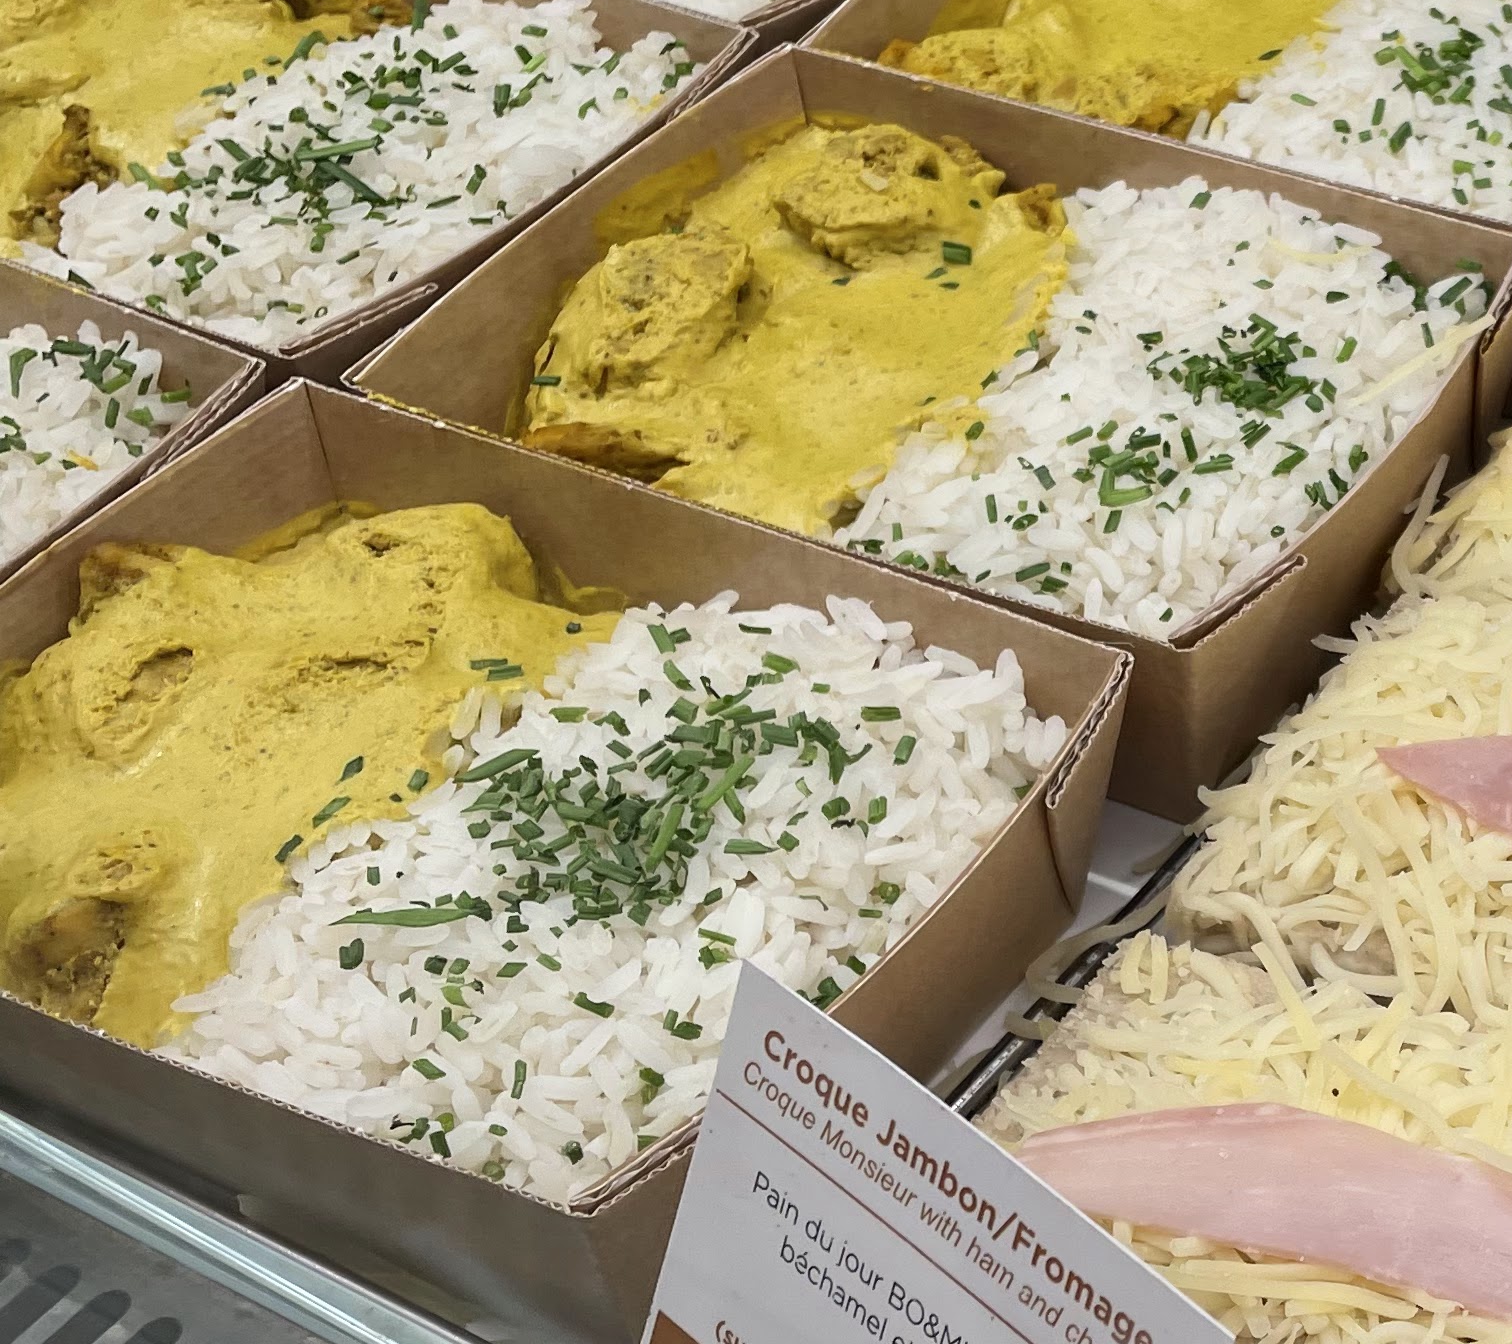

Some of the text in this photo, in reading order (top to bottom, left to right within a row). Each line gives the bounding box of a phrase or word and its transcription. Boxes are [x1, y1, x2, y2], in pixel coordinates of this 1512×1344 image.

[763, 1030, 869, 1127] Croque
[744, 1062, 816, 1130] Croque
[820, 1120, 918, 1208] Monsieur
[919, 1202, 962, 1247] with
[965, 1236, 1014, 1290] ham
[1018, 1285, 1064, 1328] and
[752, 1171, 800, 1225] Pain
[805, 1219, 834, 1253] du
[836, 1241, 883, 1291] jour
[780, 1235, 888, 1341] béchamel
